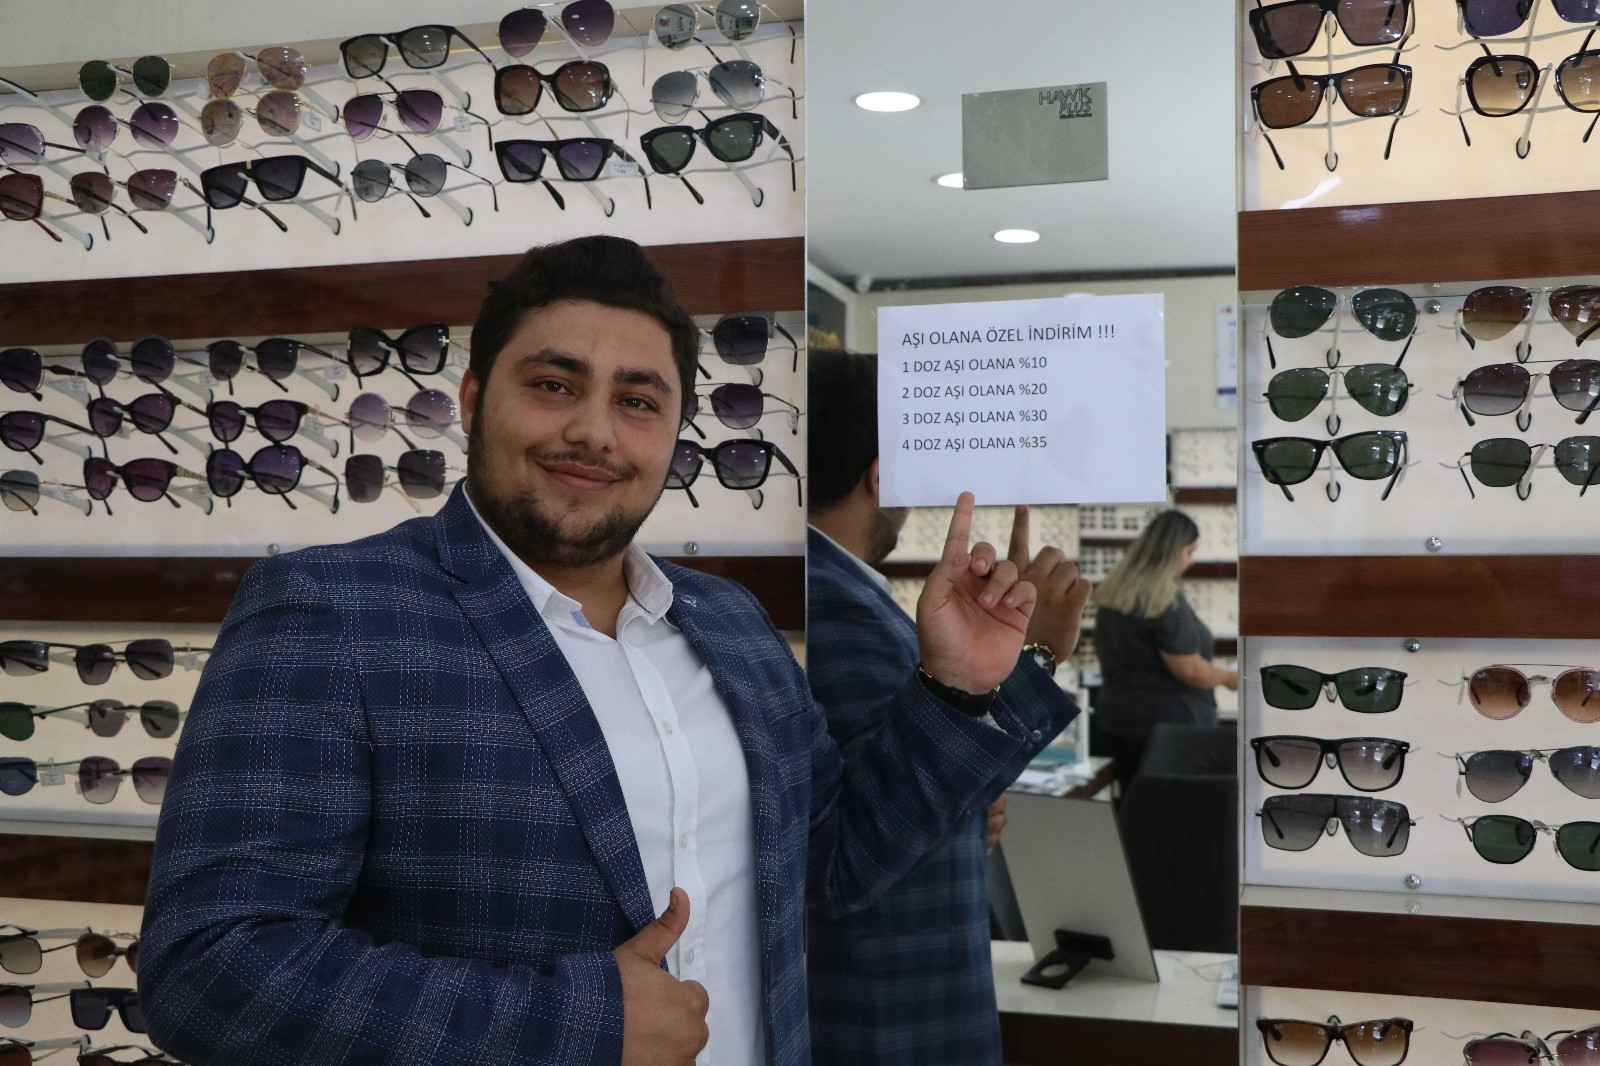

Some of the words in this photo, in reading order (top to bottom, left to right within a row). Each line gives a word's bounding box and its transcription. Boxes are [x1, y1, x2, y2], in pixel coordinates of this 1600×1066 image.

[1039, 87, 1092, 106] HAWK
[1059, 101, 1092, 115] PLUS
[901, 332, 925, 349] AŞI
[929, 329, 982, 345] OLANA
[986, 326, 1024, 343] ÖZEL
[1028, 323, 1092, 341] İNDİRİM
[1098, 323, 1115, 339] !!!
[902, 361, 910, 373] 1
[913, 360, 941, 373] DOZ
[944, 359, 965, 374] AŞI
[968, 357, 1016, 371] OLANA
[1018, 356, 1048, 369] %10
[901, 387, 910, 399] 2
[913, 386, 941, 399] DOZ
[944, 385, 965, 400] AŞI
[968, 383, 1016, 397] OLANA
[1018, 382, 1048, 396] %20
[902, 413, 910, 425] 3
[913, 412, 941, 425] DOZ
[944, 411, 965, 427] AŞI
[968, 410, 1016, 423] OLANA
[1018, 409, 1048, 422] %30
[901, 439, 910, 451] 4
[914, 438, 942, 451] DOZ
[944, 437, 965, 453] AŞI
[968, 436, 1016, 450] OLANA
[1019, 436, 1048, 449] %35
